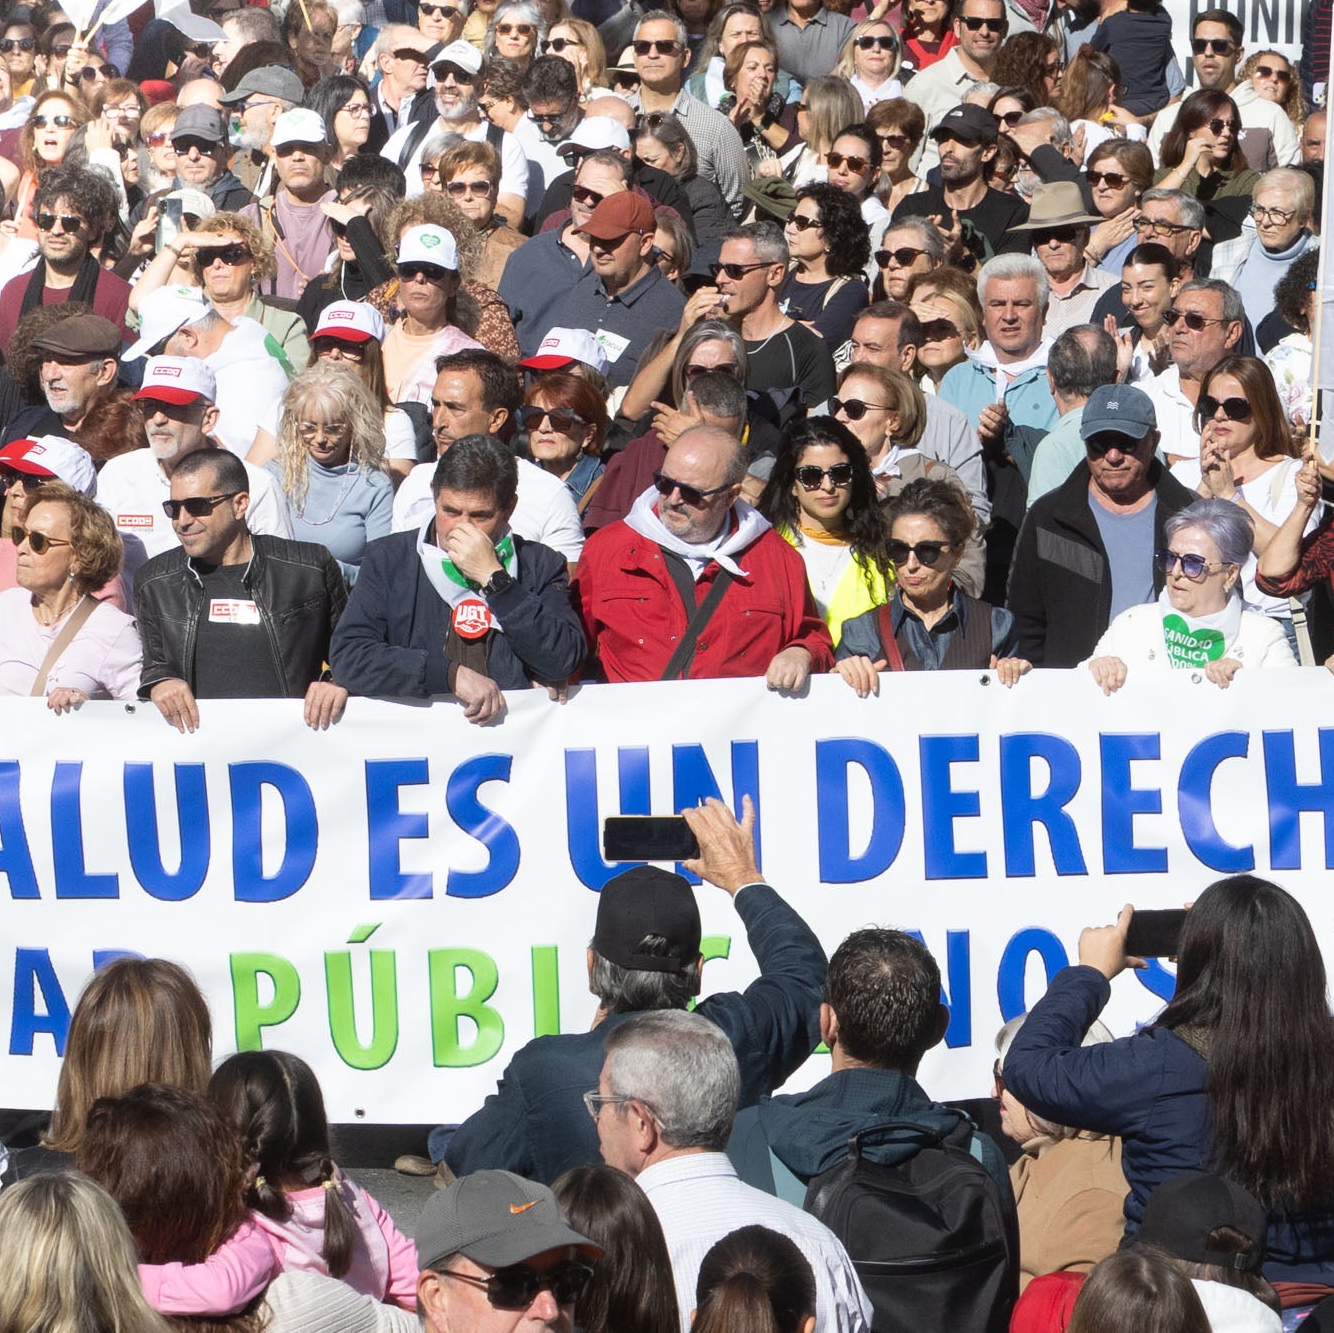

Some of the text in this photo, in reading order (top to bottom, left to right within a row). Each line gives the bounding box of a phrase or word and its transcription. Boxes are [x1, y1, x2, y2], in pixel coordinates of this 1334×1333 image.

[456, 604, 487, 622] UGT
[364, 753, 521, 900] ES
[564, 739, 763, 894] UN
